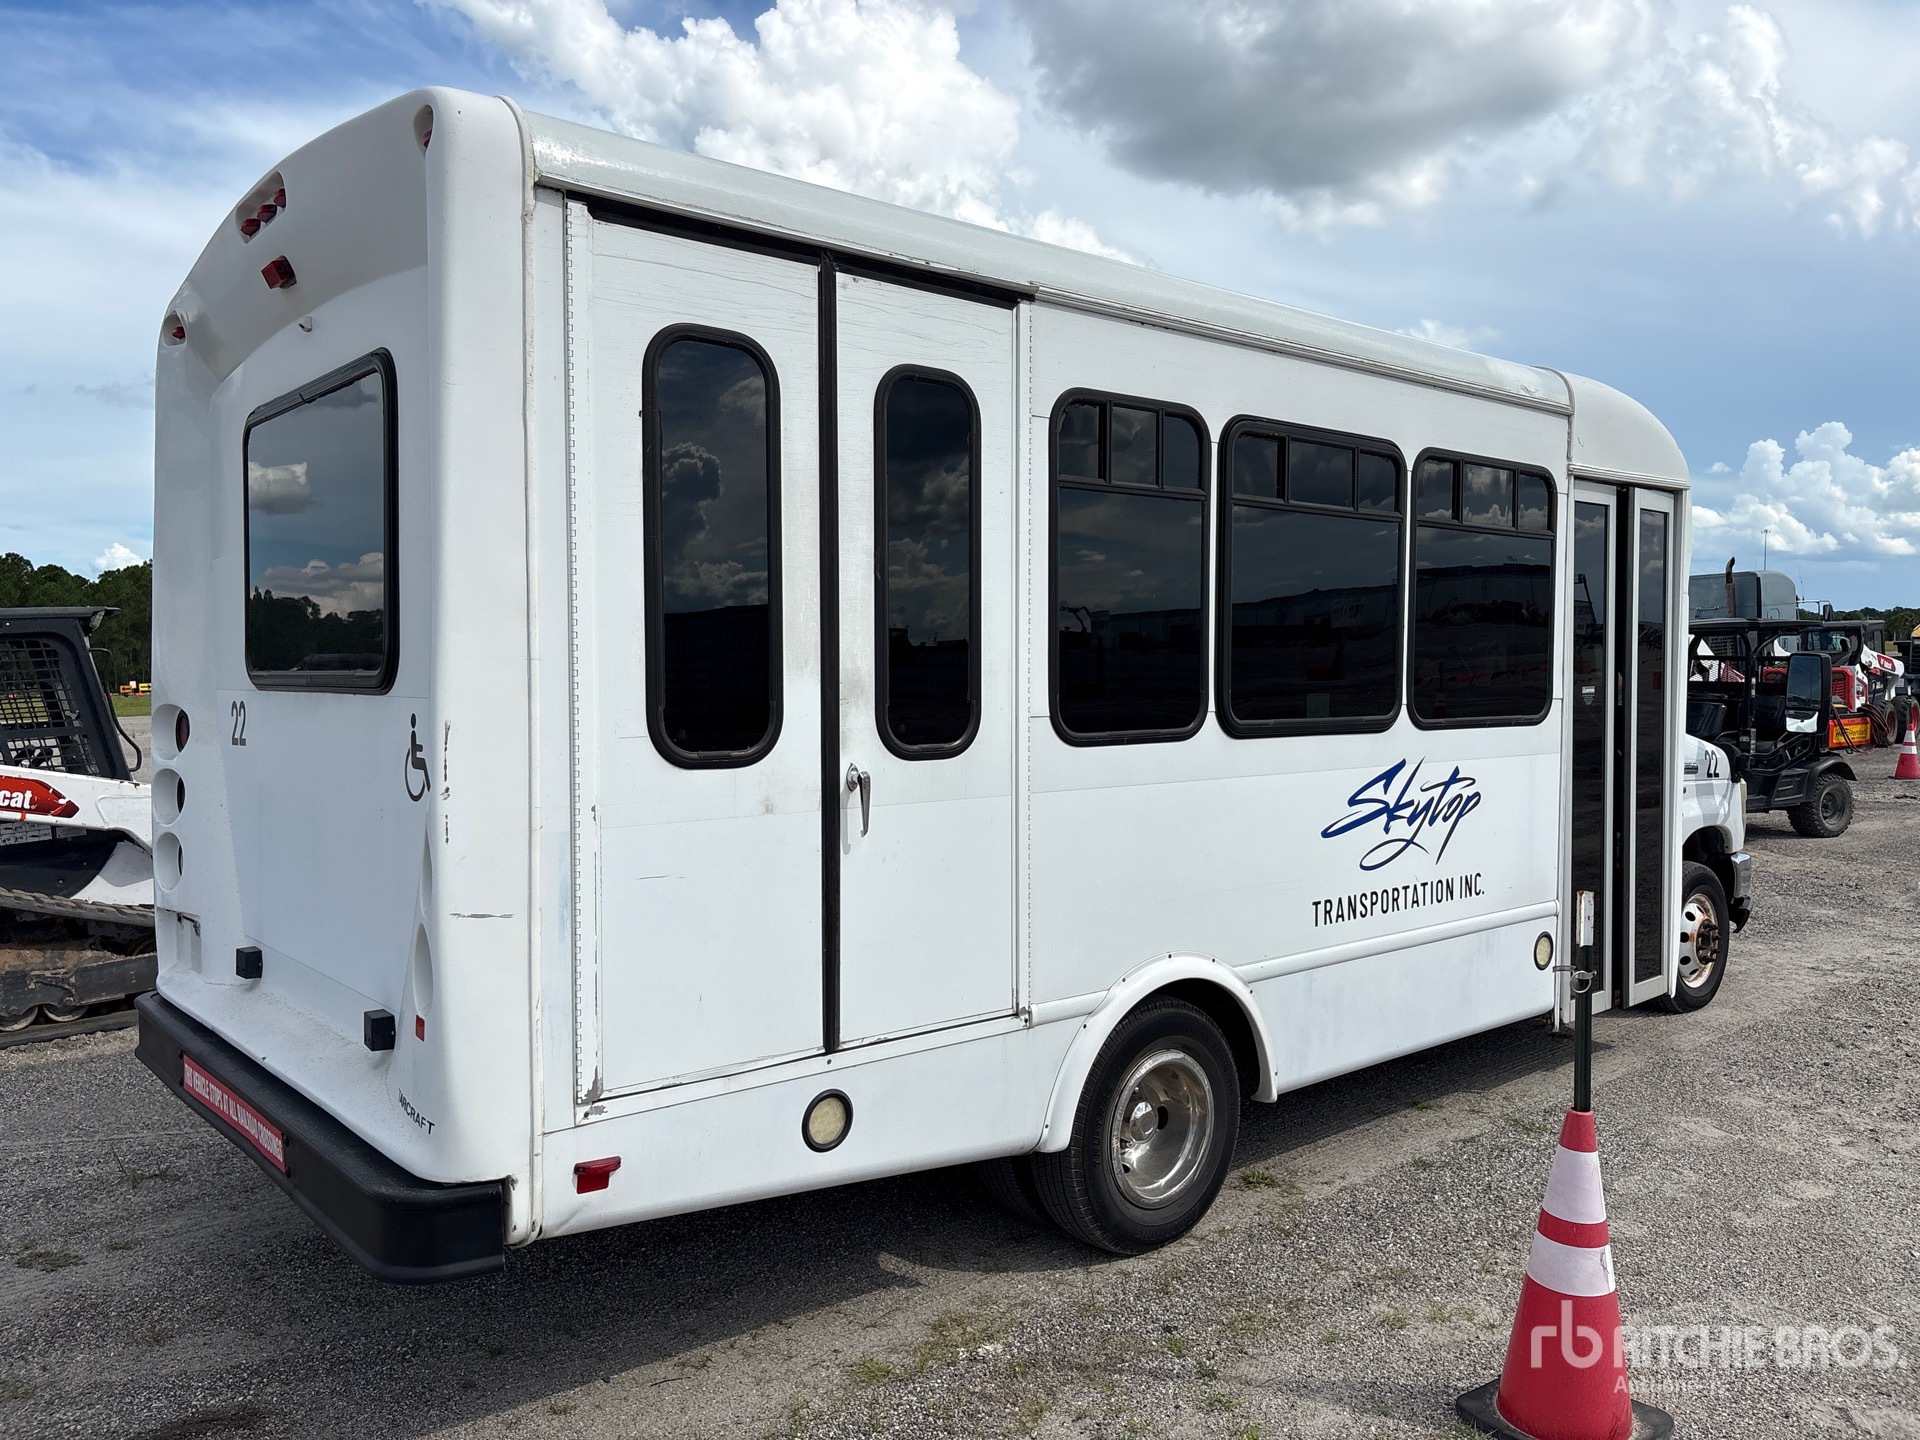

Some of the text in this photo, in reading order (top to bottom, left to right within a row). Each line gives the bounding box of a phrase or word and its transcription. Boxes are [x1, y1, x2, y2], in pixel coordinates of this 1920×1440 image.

[231, 700, 246, 746] 22
[1705, 750, 1720, 778] 22
[1321, 756, 1482, 871] Skytop
[1312, 872, 1485, 927] TRANSPORTATION INC.
[398, 1088, 436, 1135] ARCRAFT
